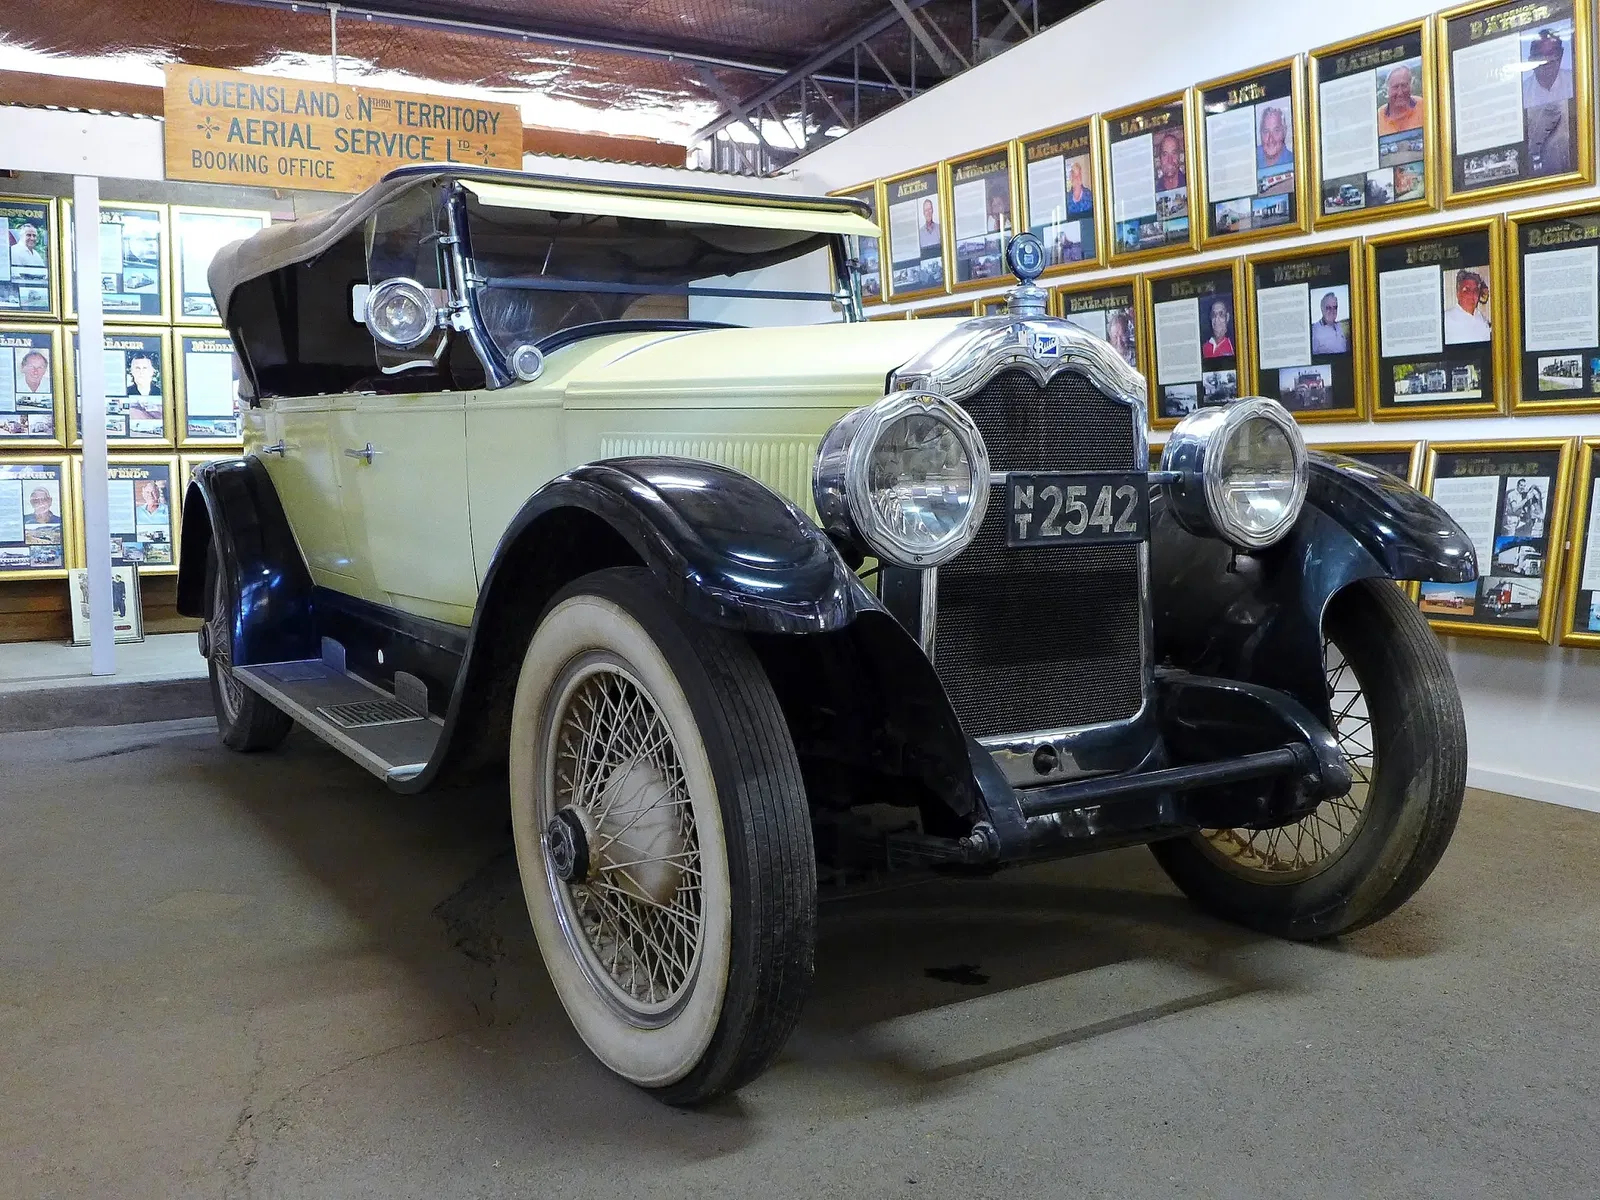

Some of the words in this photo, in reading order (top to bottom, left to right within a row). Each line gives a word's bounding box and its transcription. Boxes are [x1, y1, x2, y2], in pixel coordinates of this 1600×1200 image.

[188, 76, 340, 118] QUEENSLAND
[345, 104, 354, 121] &
[394, 99, 500, 135] TERRITORY
[227, 117, 321, 151] AERIAL
[334, 127, 435, 161] SERVICE
[192, 149, 268, 174] BOOKING
[278, 156, 335, 180] OFFICE
[898, 182, 928, 197] ALLEN
[0, 338, 32, 348] LEAN
[13, 471, 56, 480] RIGHT
[1039, 484, 1138, 537] 2542
